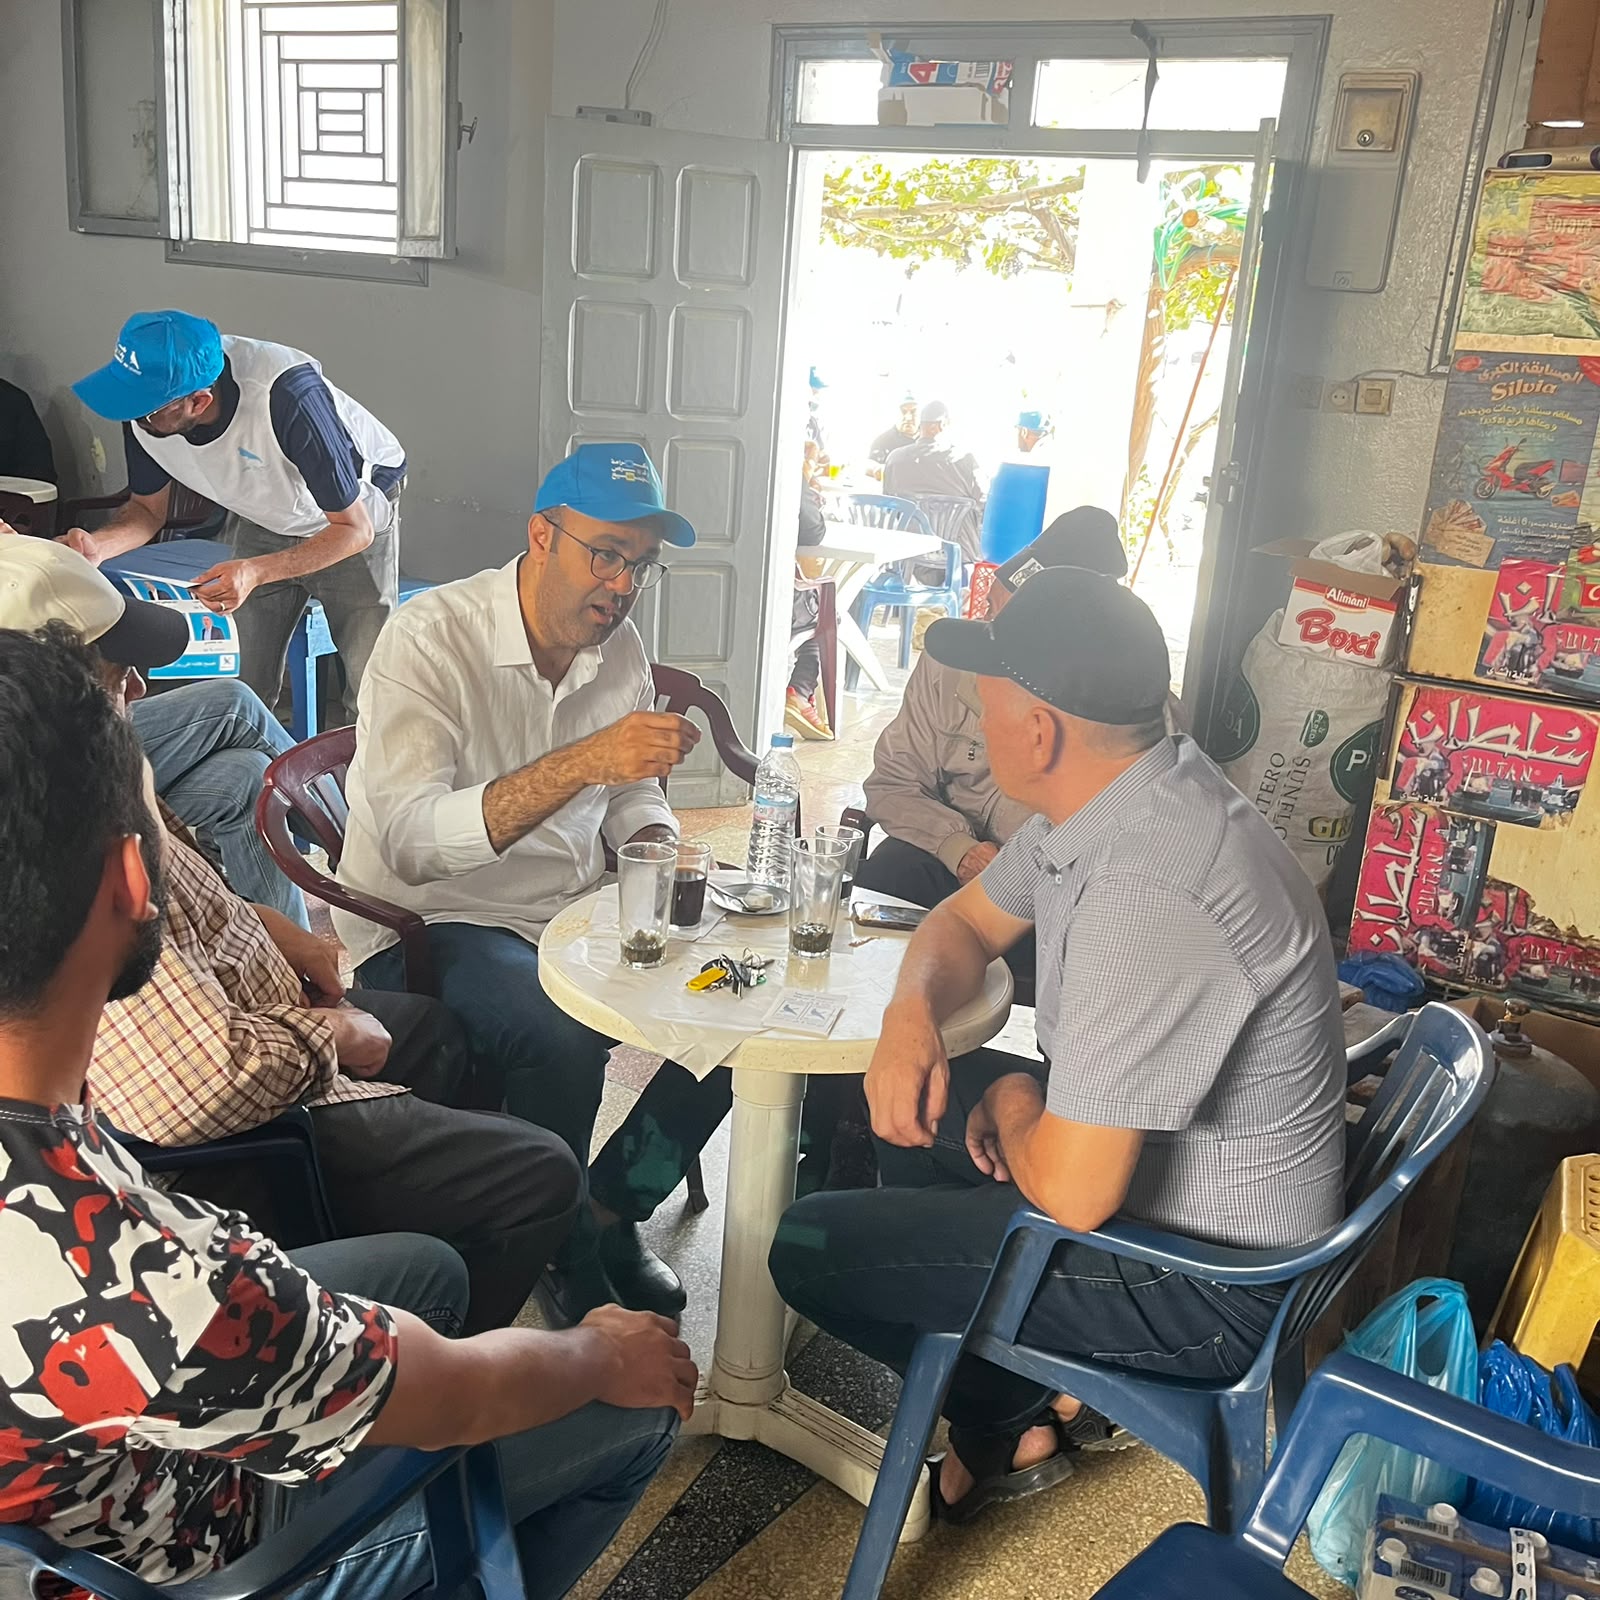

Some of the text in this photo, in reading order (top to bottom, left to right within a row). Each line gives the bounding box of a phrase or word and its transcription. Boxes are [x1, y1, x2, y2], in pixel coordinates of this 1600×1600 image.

[1490, 378, 1559, 402] Silvia
[1327, 587, 1368, 608] Alimani
[1296, 608, 1381, 659] Boxi
[1463, 756, 1534, 783] SULTAN
[1256, 752, 1285, 816] ITERO
